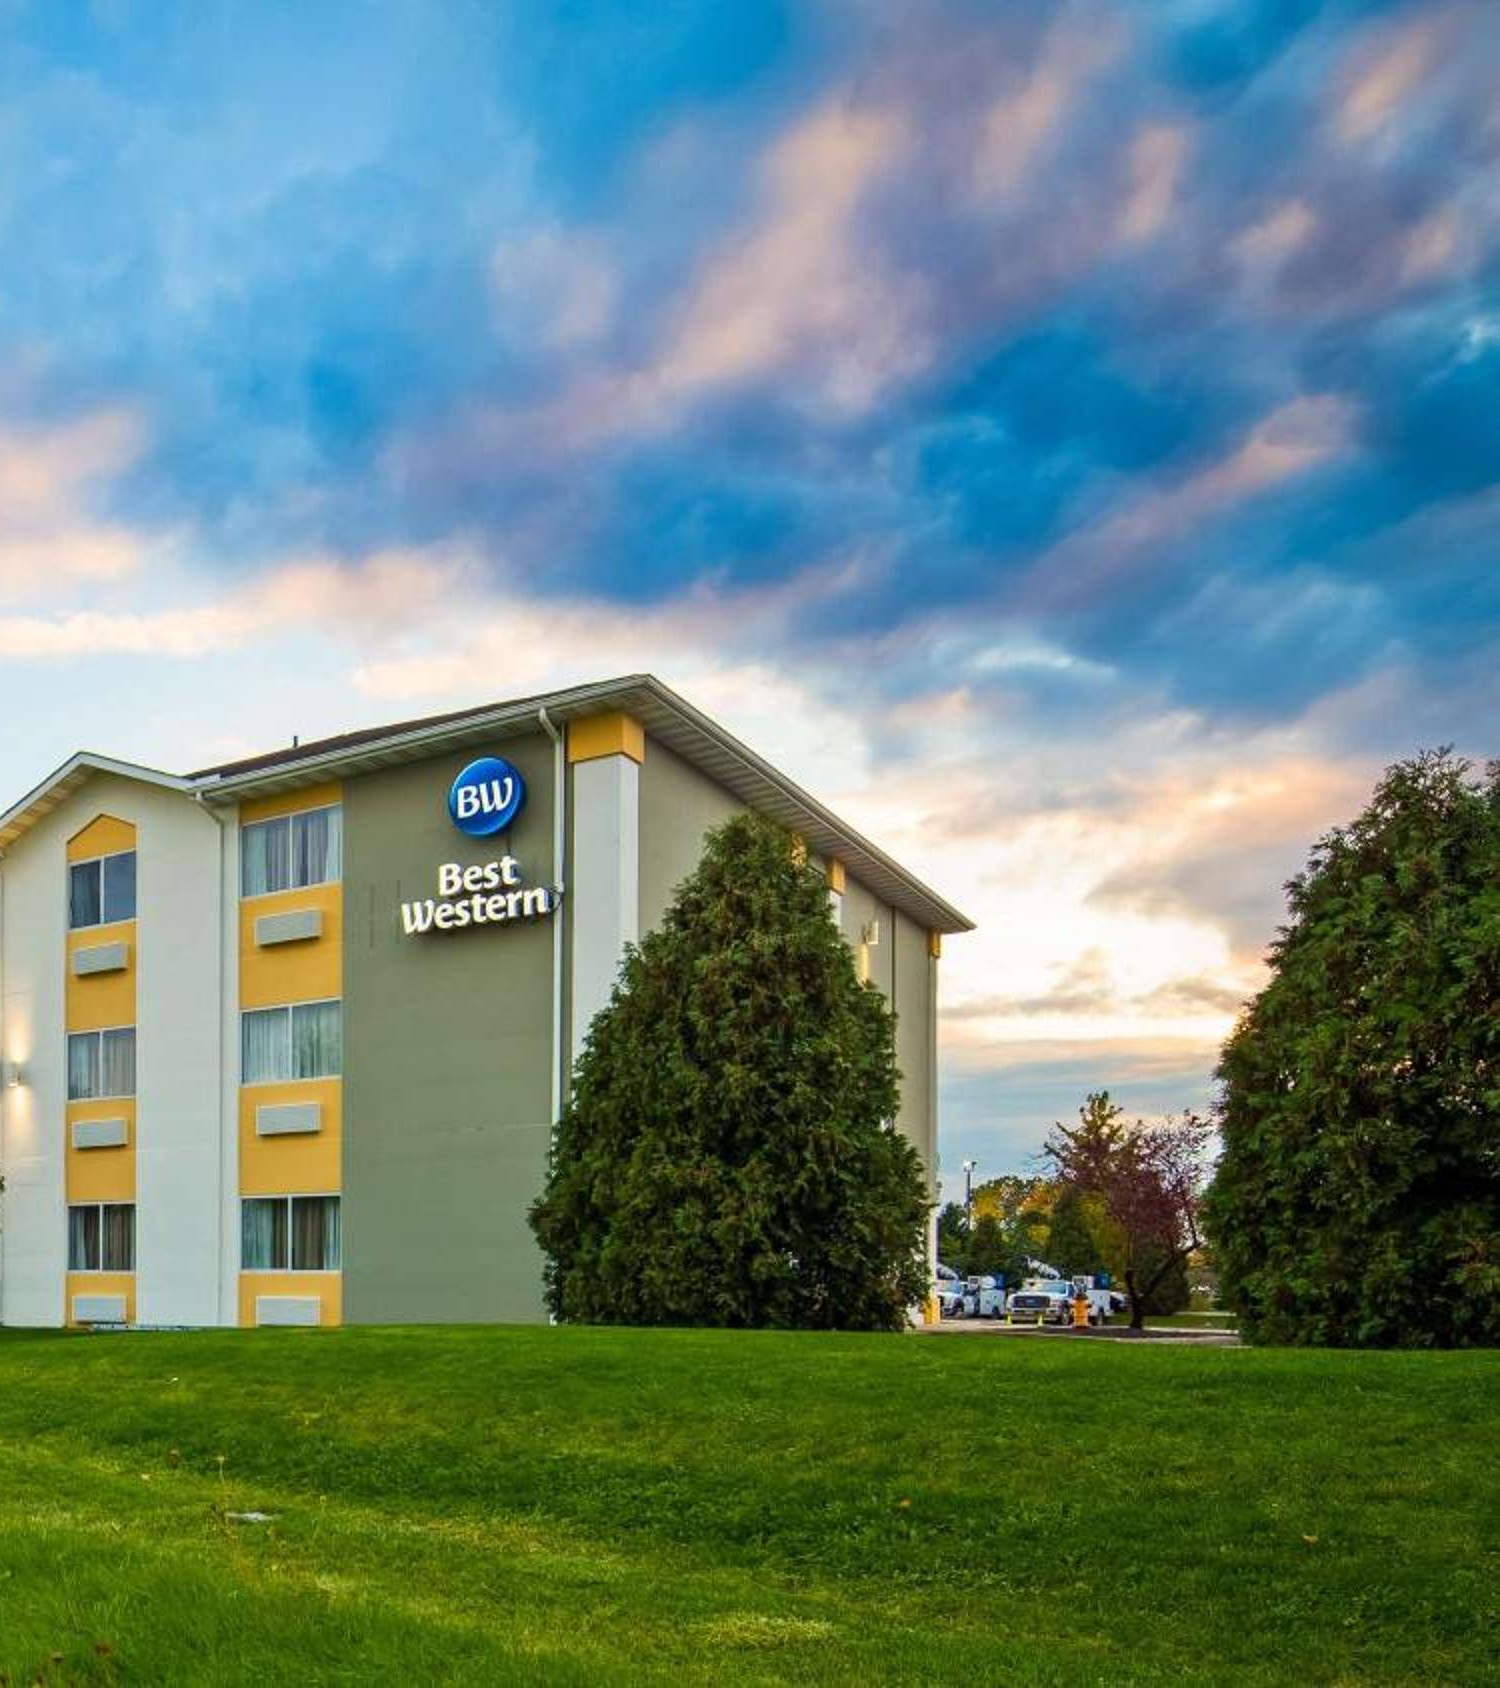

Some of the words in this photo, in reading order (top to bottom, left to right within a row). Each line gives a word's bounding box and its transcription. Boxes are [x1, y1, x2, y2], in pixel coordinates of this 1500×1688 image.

[457, 777, 513, 819] BW
[438, 855, 518, 895] Best
[401, 887, 549, 934] Western
